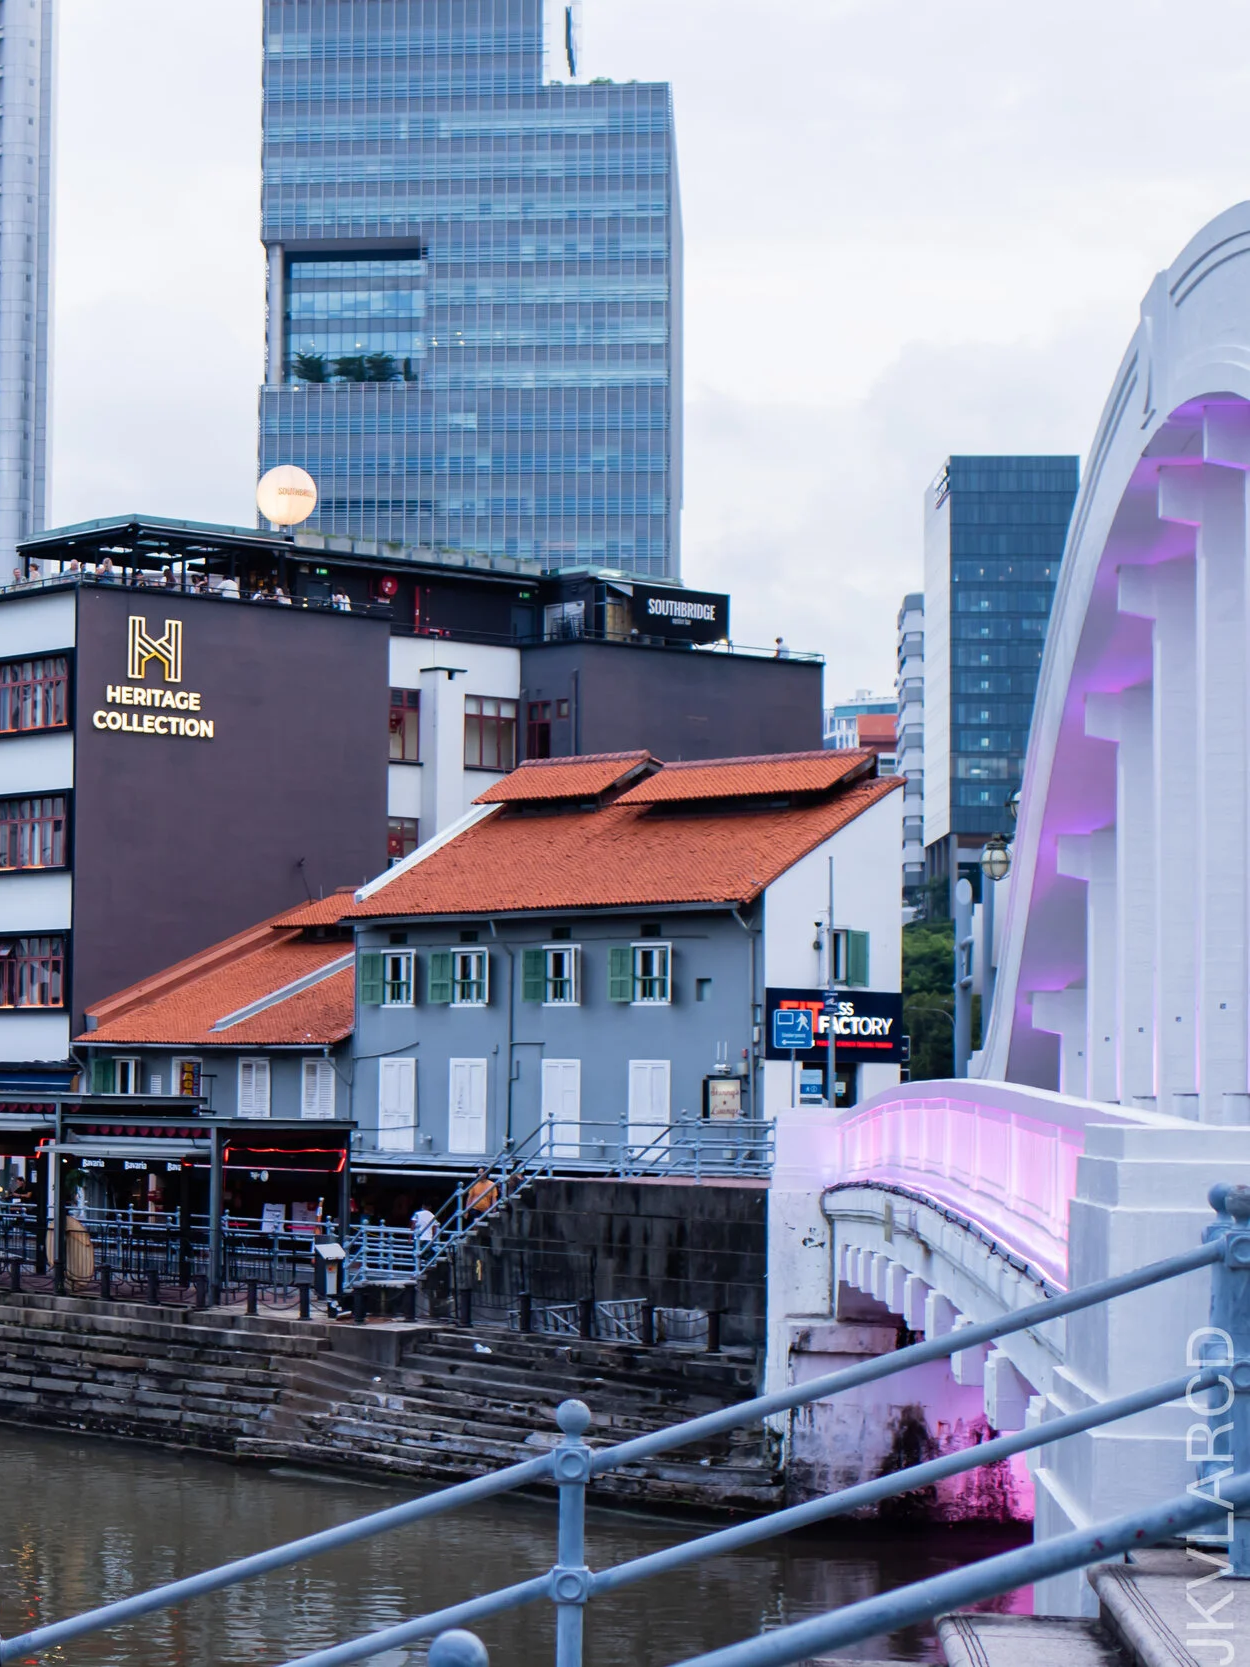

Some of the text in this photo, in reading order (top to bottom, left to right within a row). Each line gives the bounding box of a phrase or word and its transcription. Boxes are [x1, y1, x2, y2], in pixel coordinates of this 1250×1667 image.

[648, 598, 716, 621] SOUTHBRIDGE
[106, 684, 201, 711] HERITAGE
[92, 710, 214, 738] COLLECTION
[82, 1158, 105, 1168] Bavaria
[124, 1160, 147, 1170] Bavaria
[167, 1161, 182, 1172] Bava
